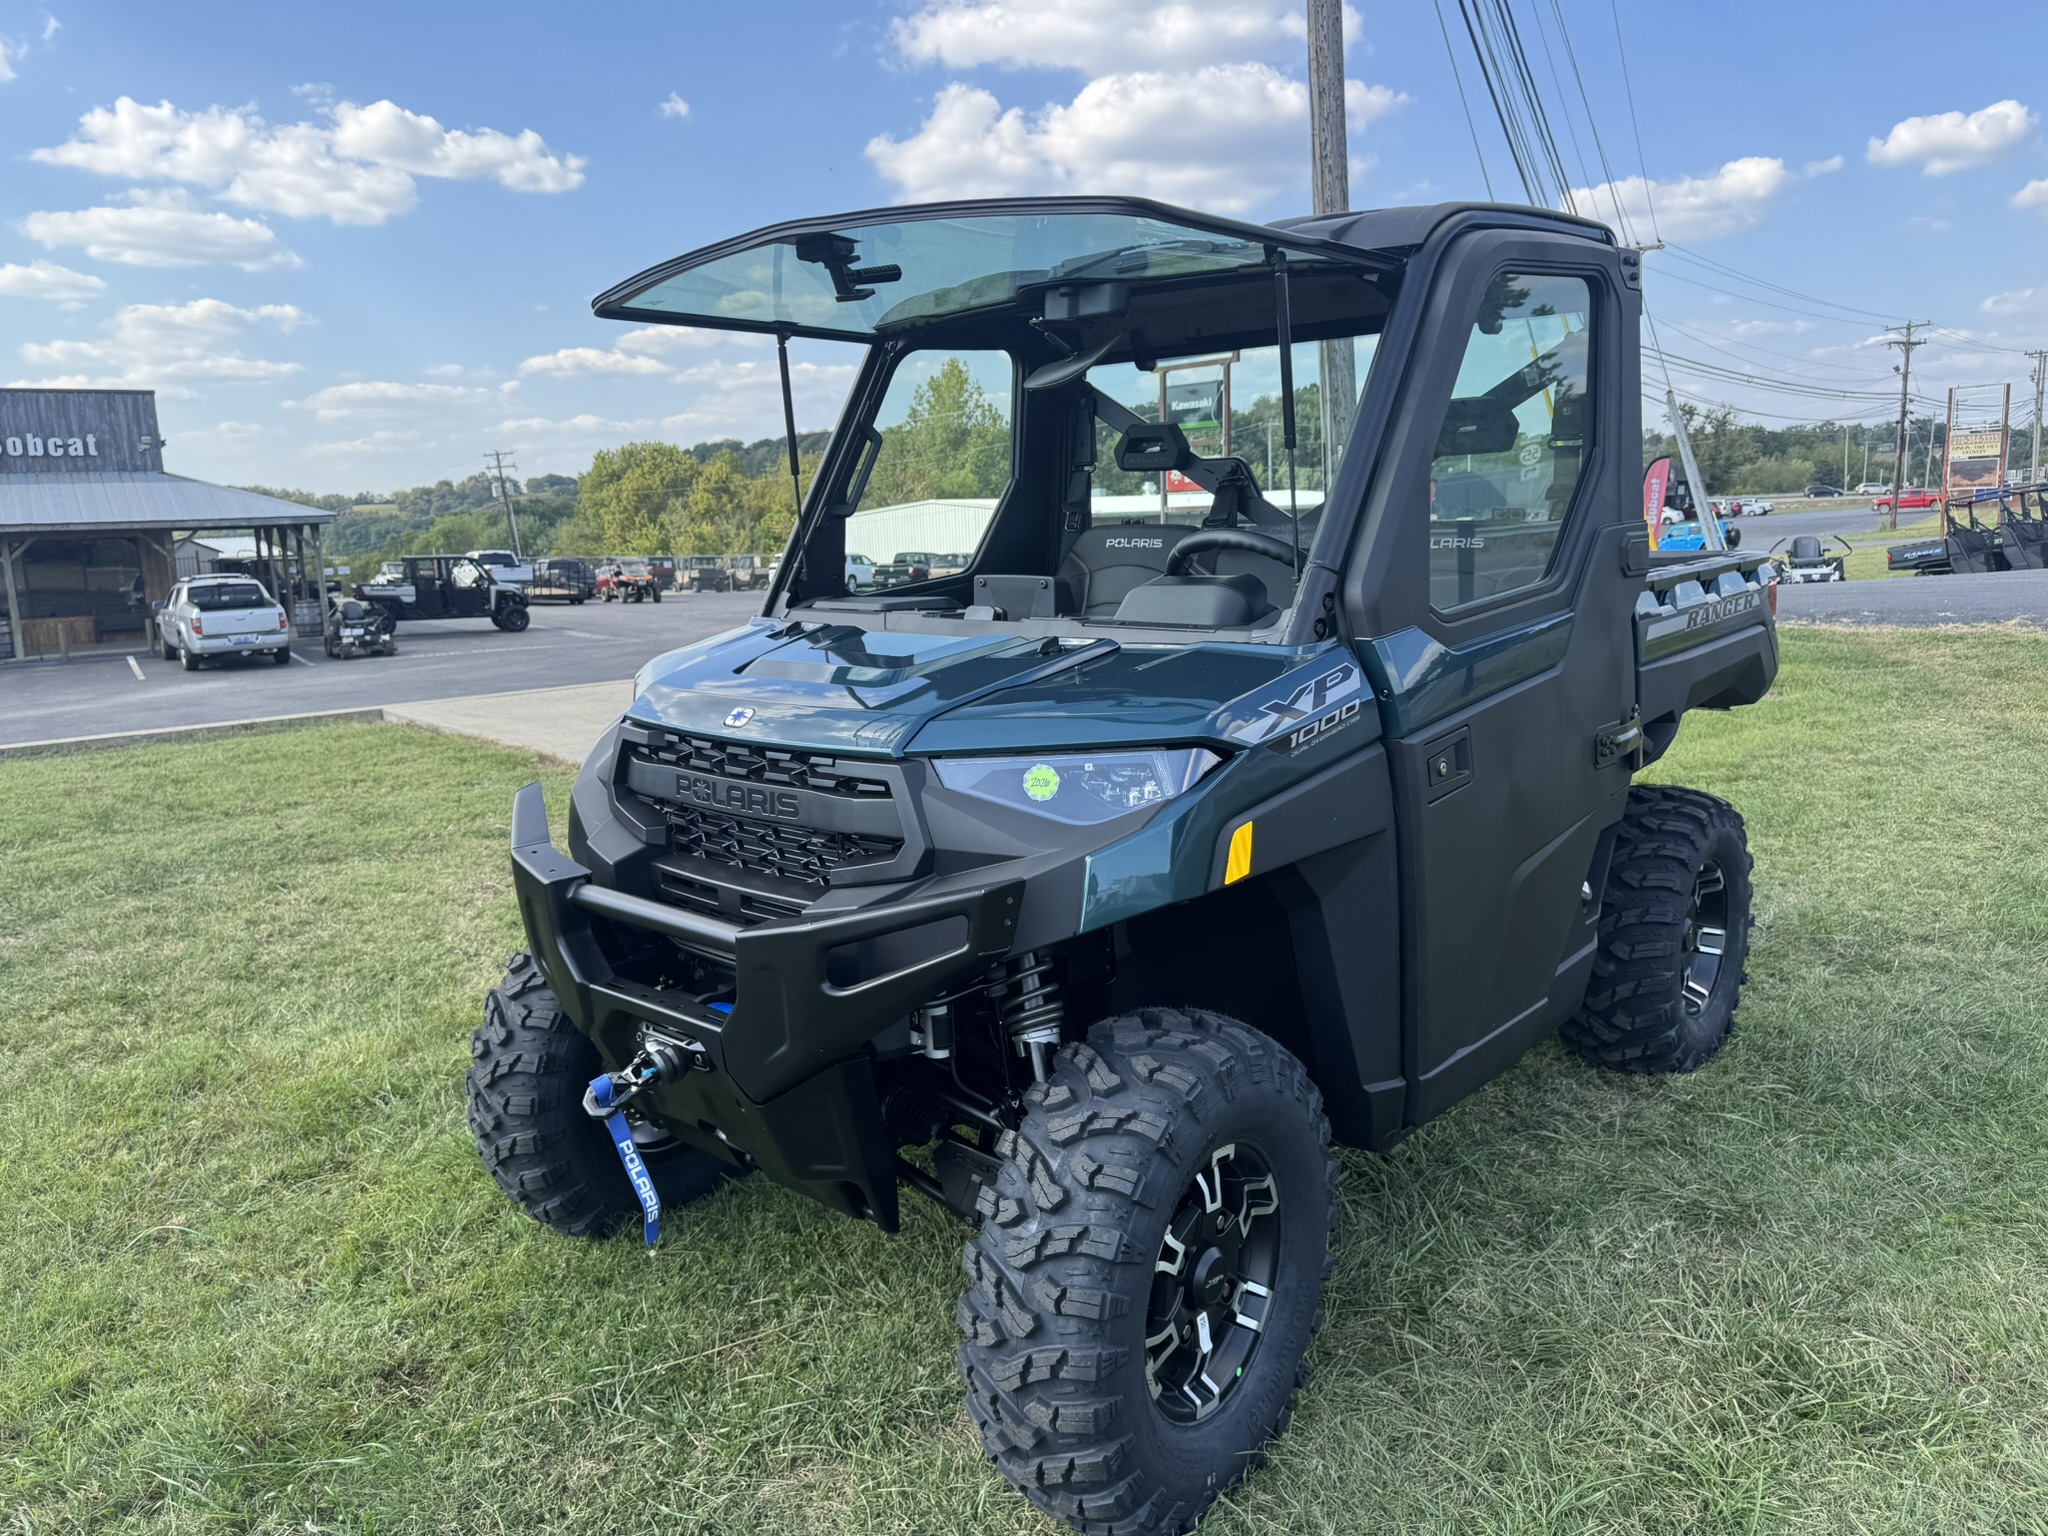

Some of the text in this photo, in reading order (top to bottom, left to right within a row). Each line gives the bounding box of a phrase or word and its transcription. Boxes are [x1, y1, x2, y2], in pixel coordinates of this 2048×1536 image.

[1171, 397, 1212, 411] Kawasaki
[0, 433, 98, 457] obcat
[1106, 538, 1163, 548] POLARIS
[1685, 592, 1755, 631] RANGER
[1258, 662, 1356, 742] XP
[1290, 698, 1360, 749] 1000
[675, 774, 800, 820] POLARIS
[1031, 777, 1051, 787] 2026
[619, 1139, 659, 1223] POLARIS
